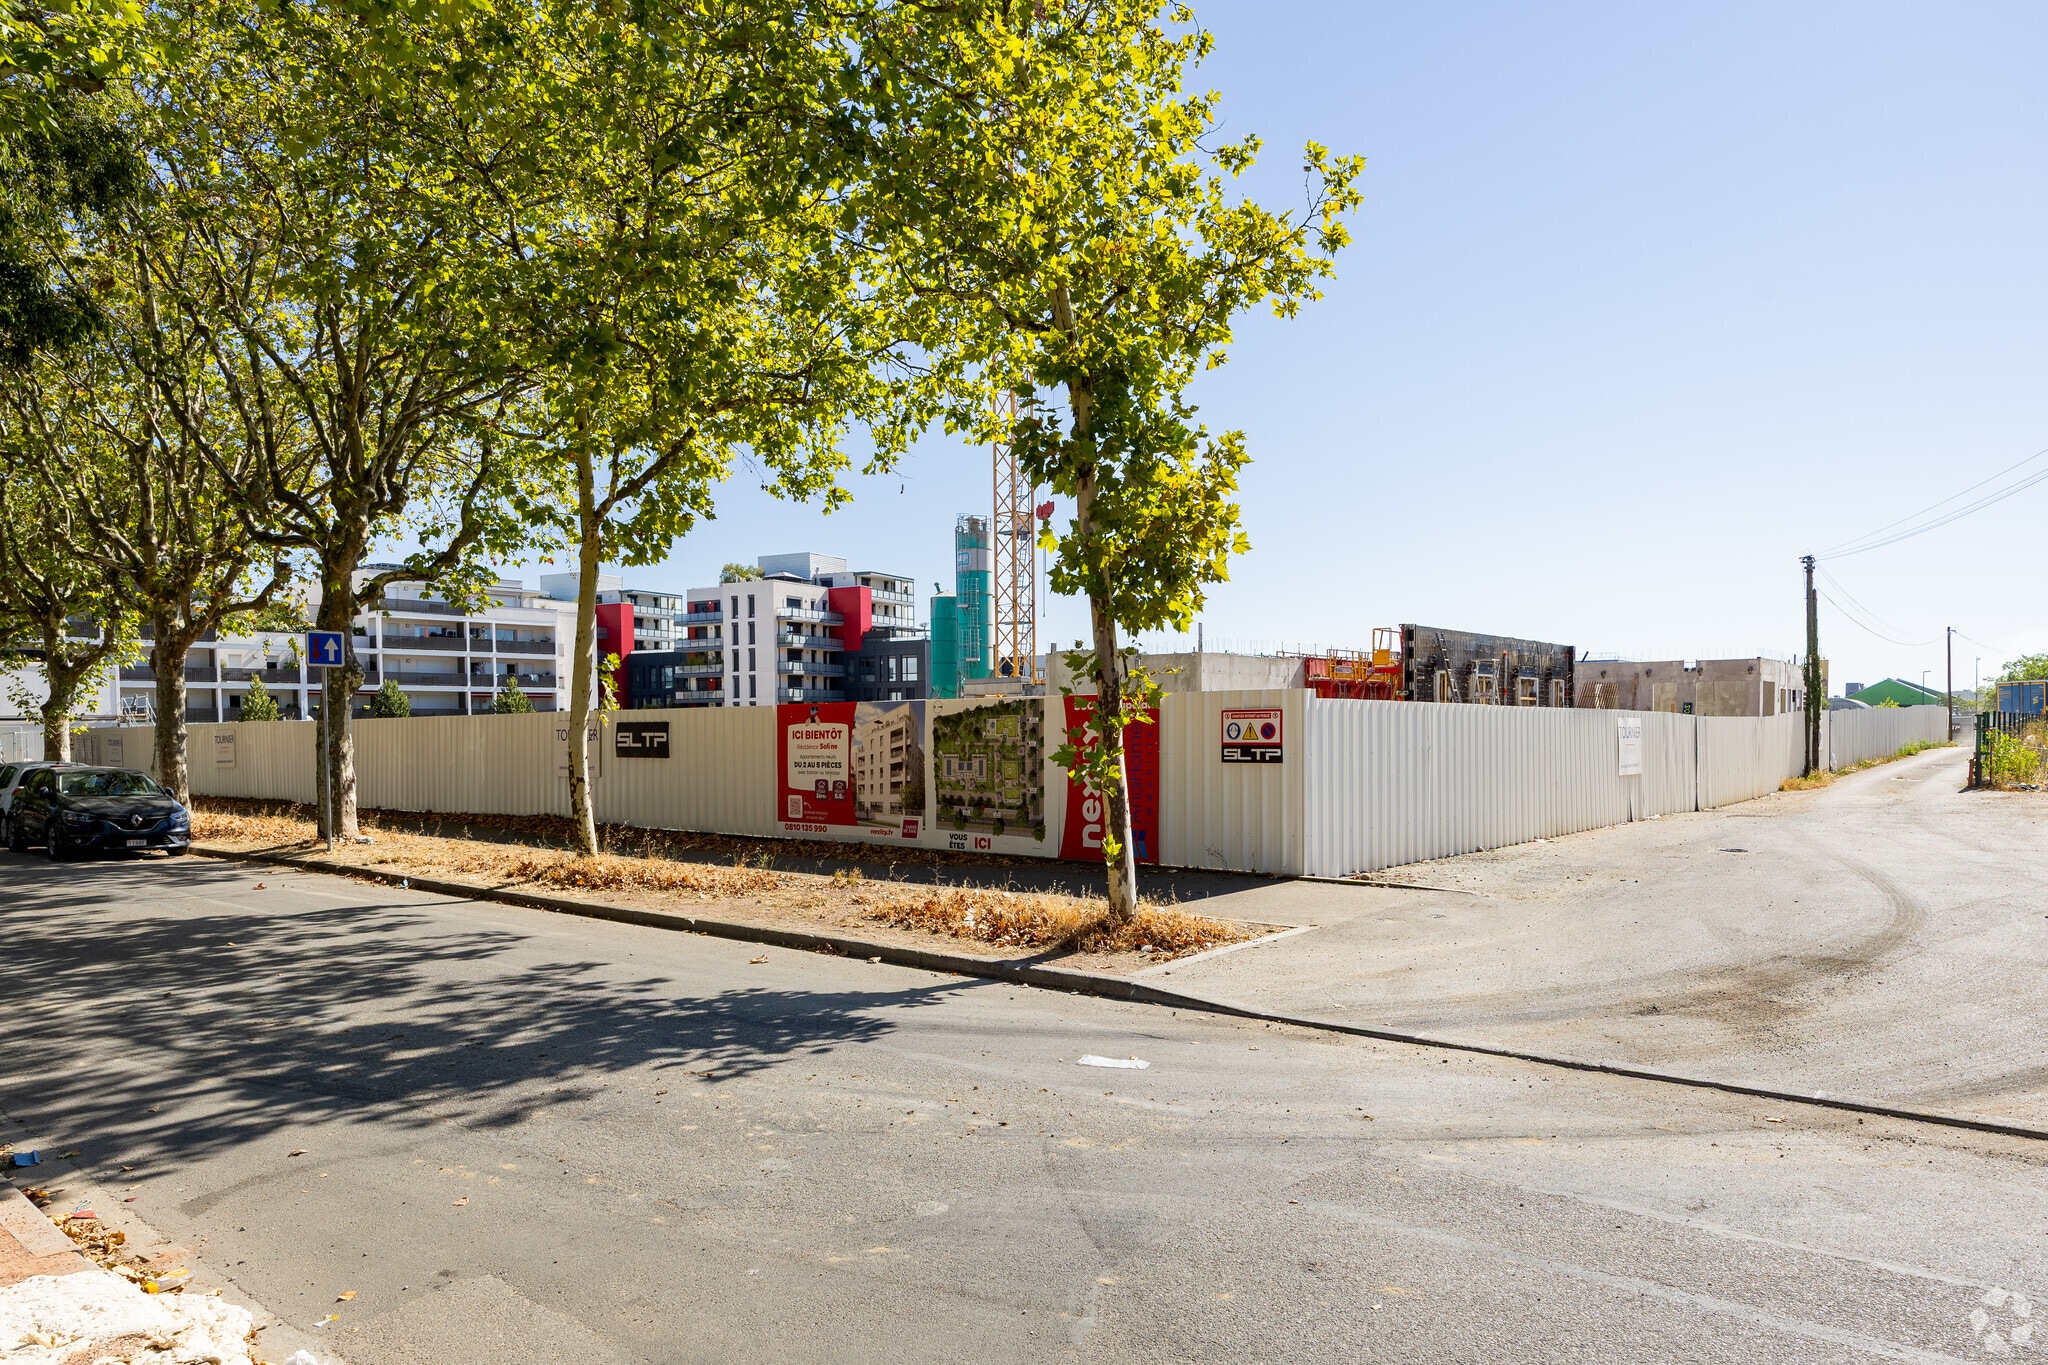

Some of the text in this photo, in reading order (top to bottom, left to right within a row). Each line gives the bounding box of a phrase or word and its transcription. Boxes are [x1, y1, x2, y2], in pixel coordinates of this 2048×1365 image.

[616, 732, 667, 747] SLTP
[792, 727, 842, 740] ICI BIENTÔT
[1224, 748, 1281, 760] SLTP
[821, 760, 842, 768] PIÈCES
[870, 828, 894, 836] nexity.fr
[949, 840, 965, 850] ÊTES
[974, 837, 991, 850] ICI
